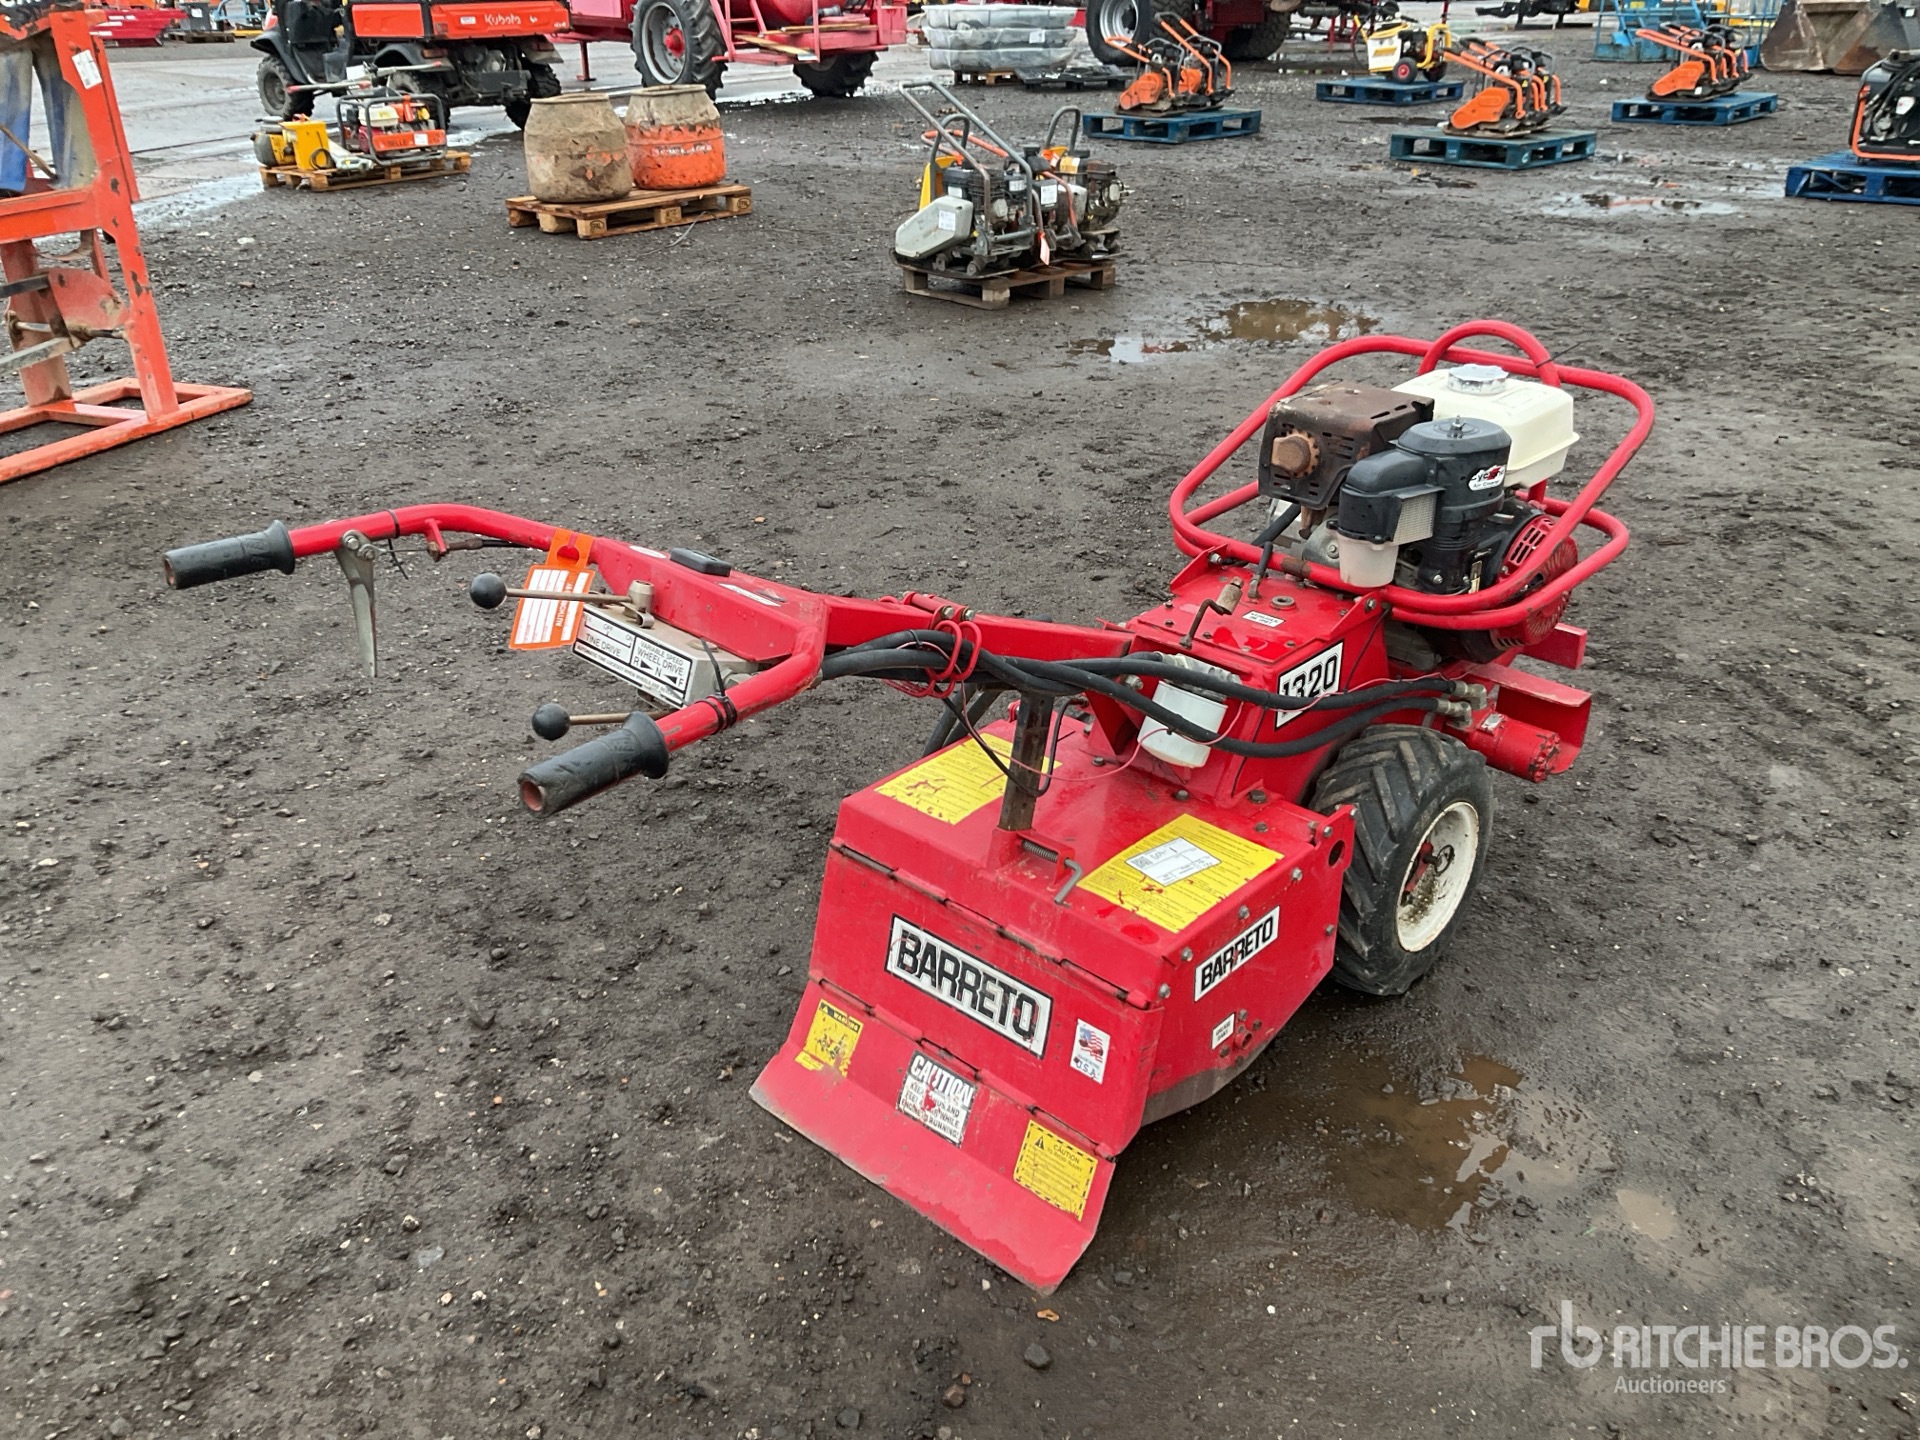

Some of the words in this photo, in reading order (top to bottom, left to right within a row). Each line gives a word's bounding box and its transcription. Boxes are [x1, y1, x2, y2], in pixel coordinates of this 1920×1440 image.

[484, 13, 521, 25] Kubota
[603, 623, 613, 631] OFF
[625, 634, 633, 642] ON
[586, 633, 600, 647] TINE
[601, 641, 621, 657] DRIVE
[640, 642, 665, 657] VARIABLE
[666, 653, 684, 667] SPEED
[633, 656, 640, 666] R
[655, 667, 662, 677] N
[678, 678, 685, 687] F
[637, 647, 661, 666] WHEEL
[662, 659, 684, 676] DRIVE
[1200, 916, 1273, 992] BARRETO
[897, 929, 1040, 1041] BARRETO
[910, 1055, 975, 1108] CAUTION
[940, 1111, 960, 1128] WHILE
[948, 1104, 960, 1117] AND
[1053, 1144, 1080, 1164] CAUTION
